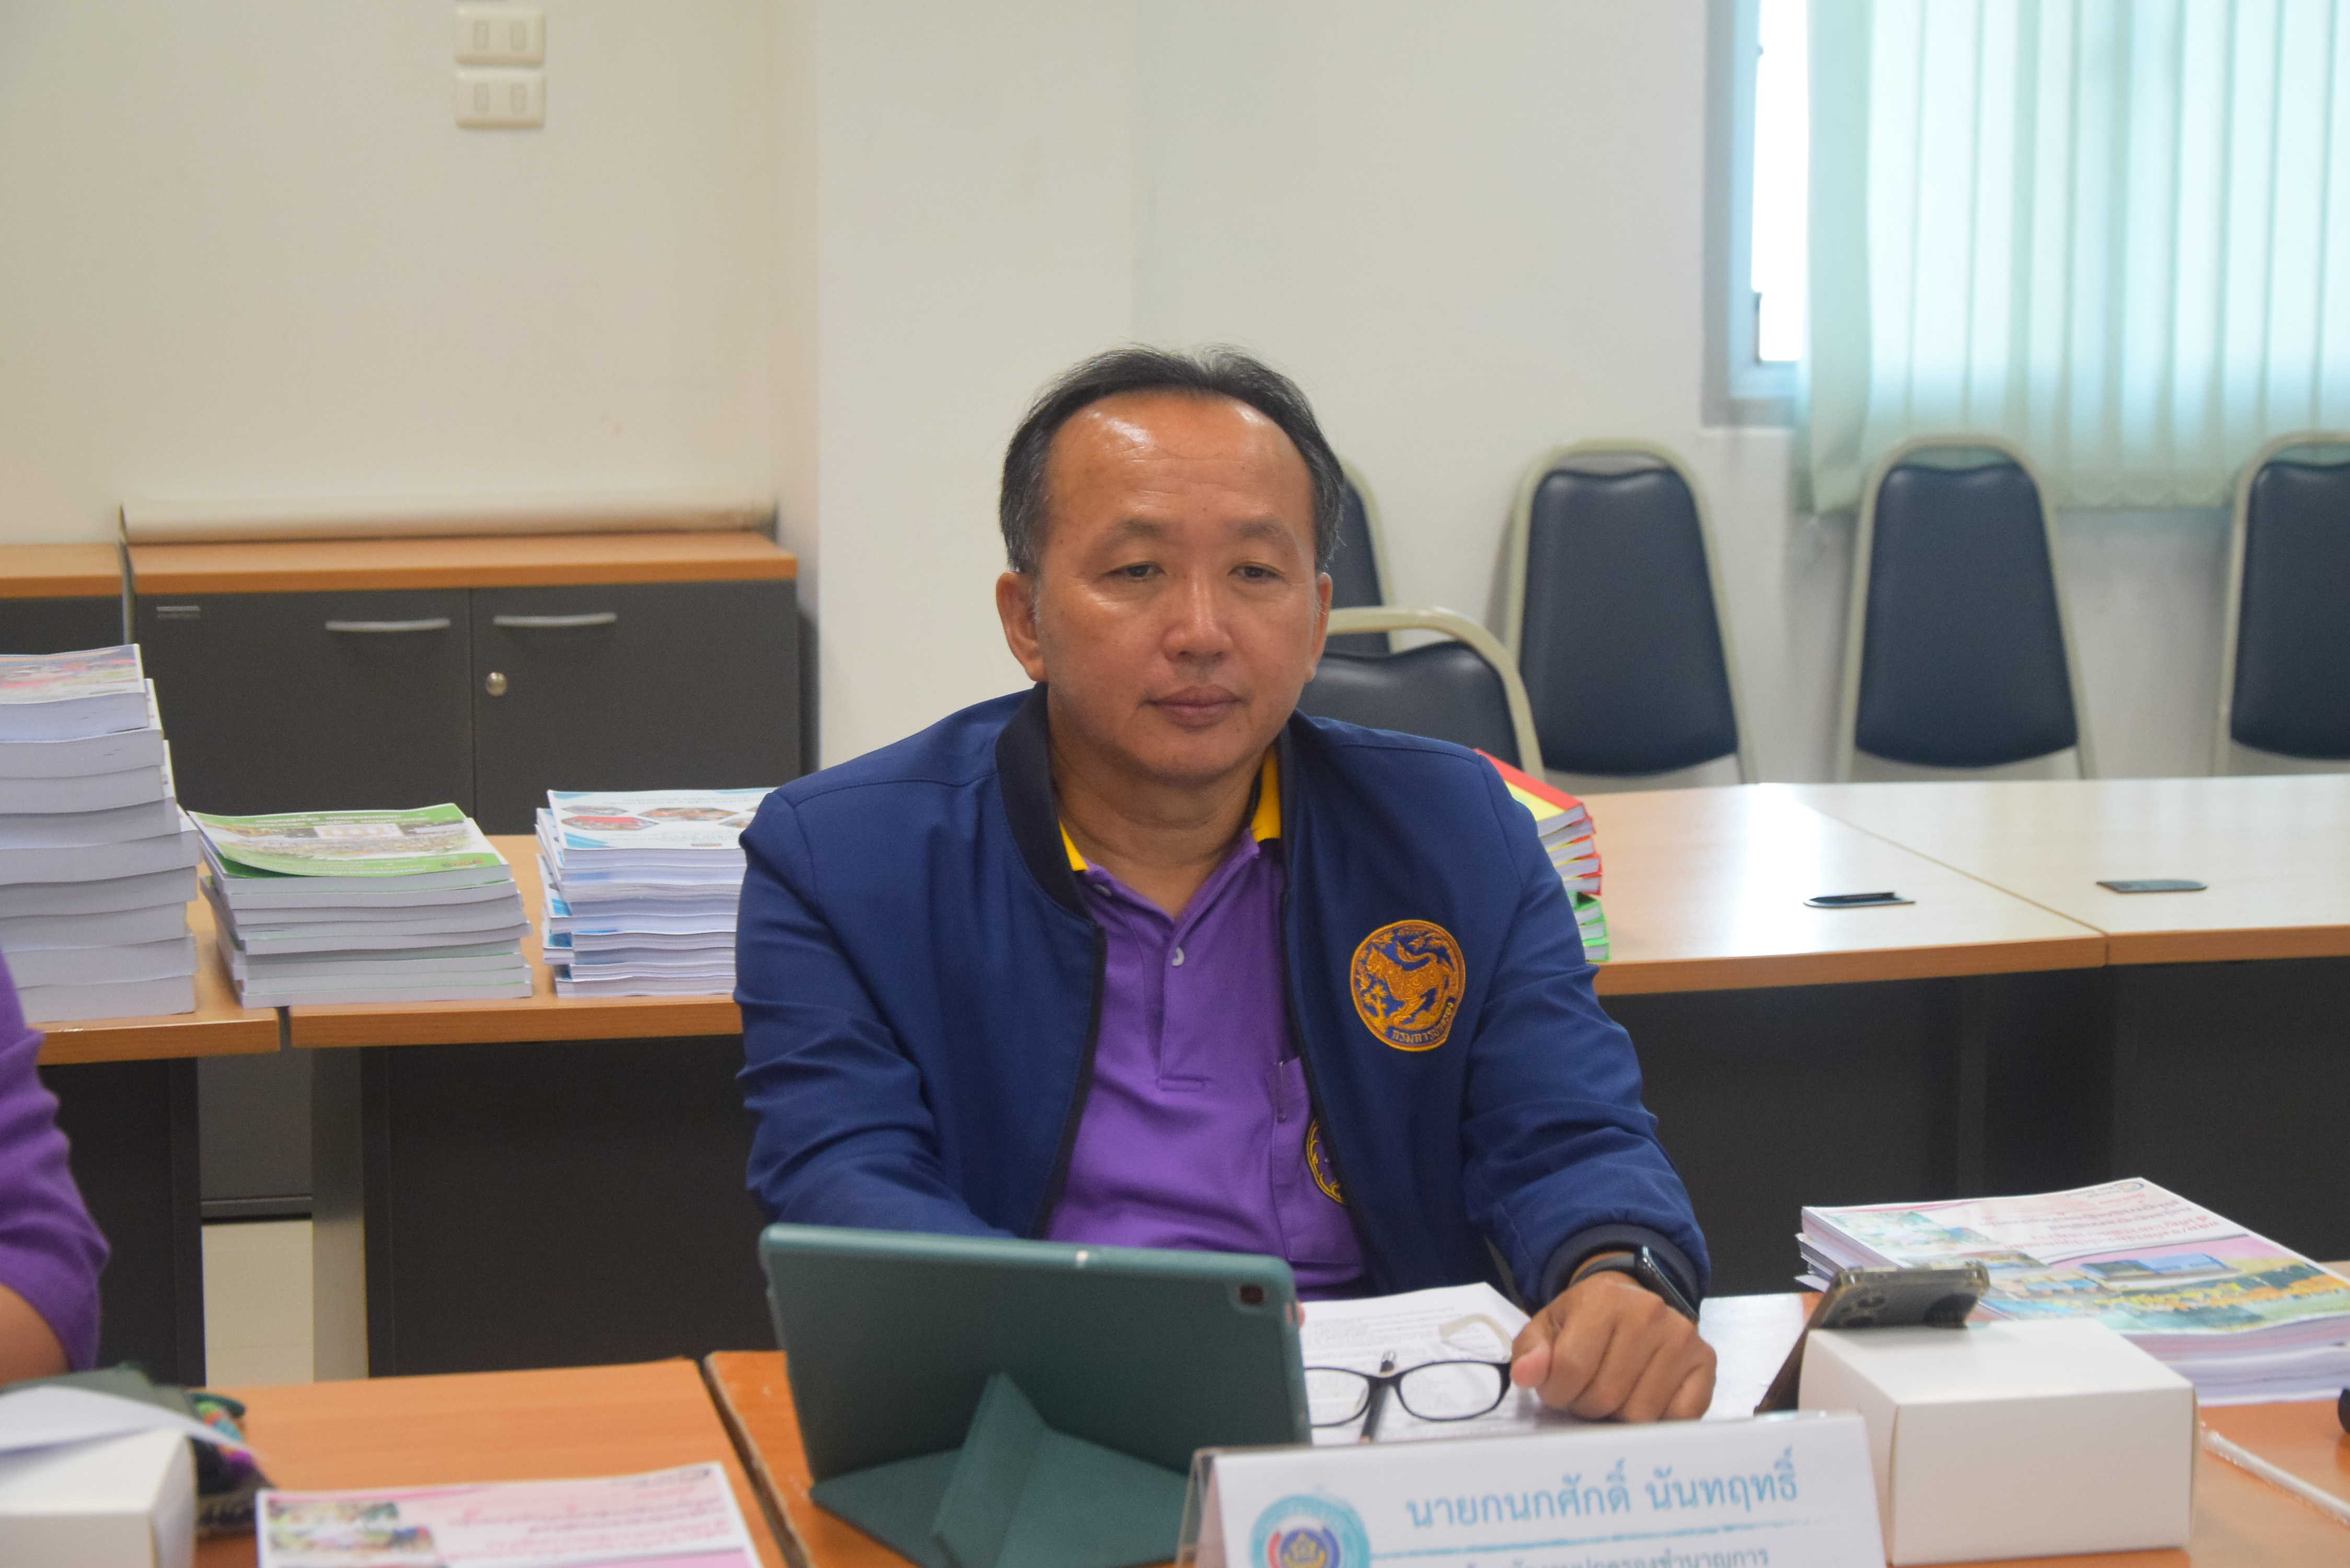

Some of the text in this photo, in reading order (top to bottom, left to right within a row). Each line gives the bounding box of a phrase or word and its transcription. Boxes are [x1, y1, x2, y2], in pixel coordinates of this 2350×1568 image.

[1406, 1446, 1798, 1528] นายกนกศักดิ์ นันทฤทธิ์
